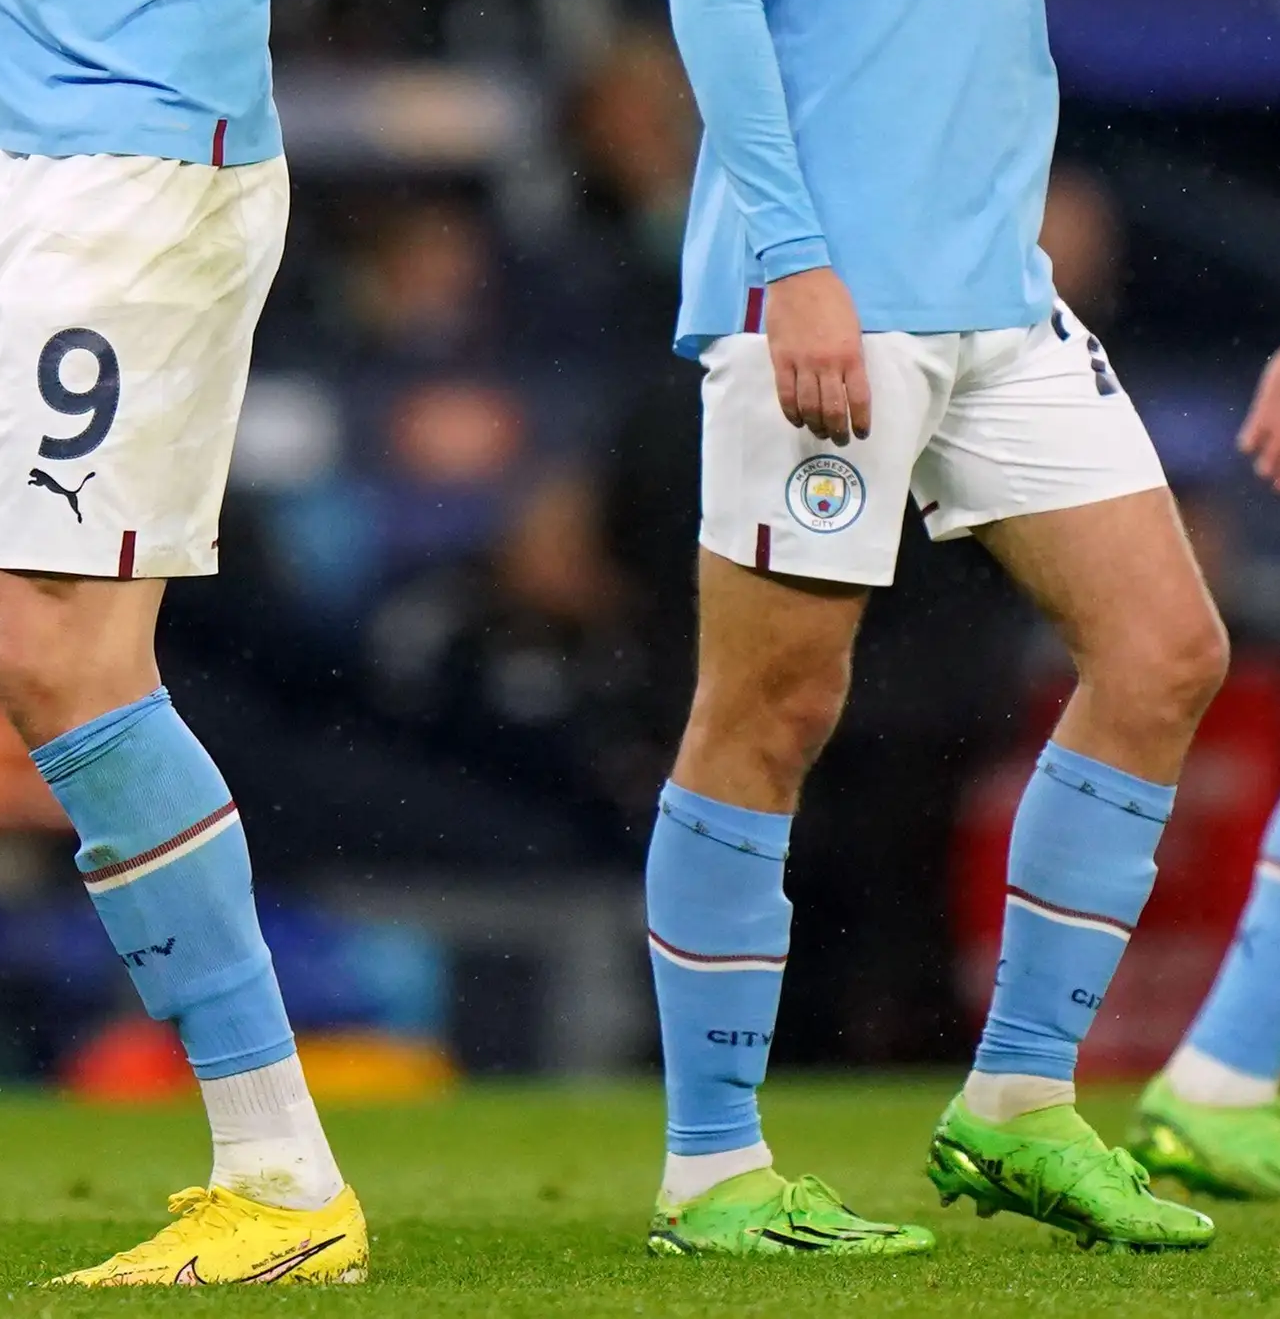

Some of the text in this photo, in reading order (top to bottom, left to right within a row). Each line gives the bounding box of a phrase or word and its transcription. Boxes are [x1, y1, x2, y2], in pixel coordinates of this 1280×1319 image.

[37, 327, 120, 460] 9
[795, 461, 858, 487] MANCHESTER
[811, 519, 835, 528] CITY
[1071, 988, 1103, 1010] CIT
